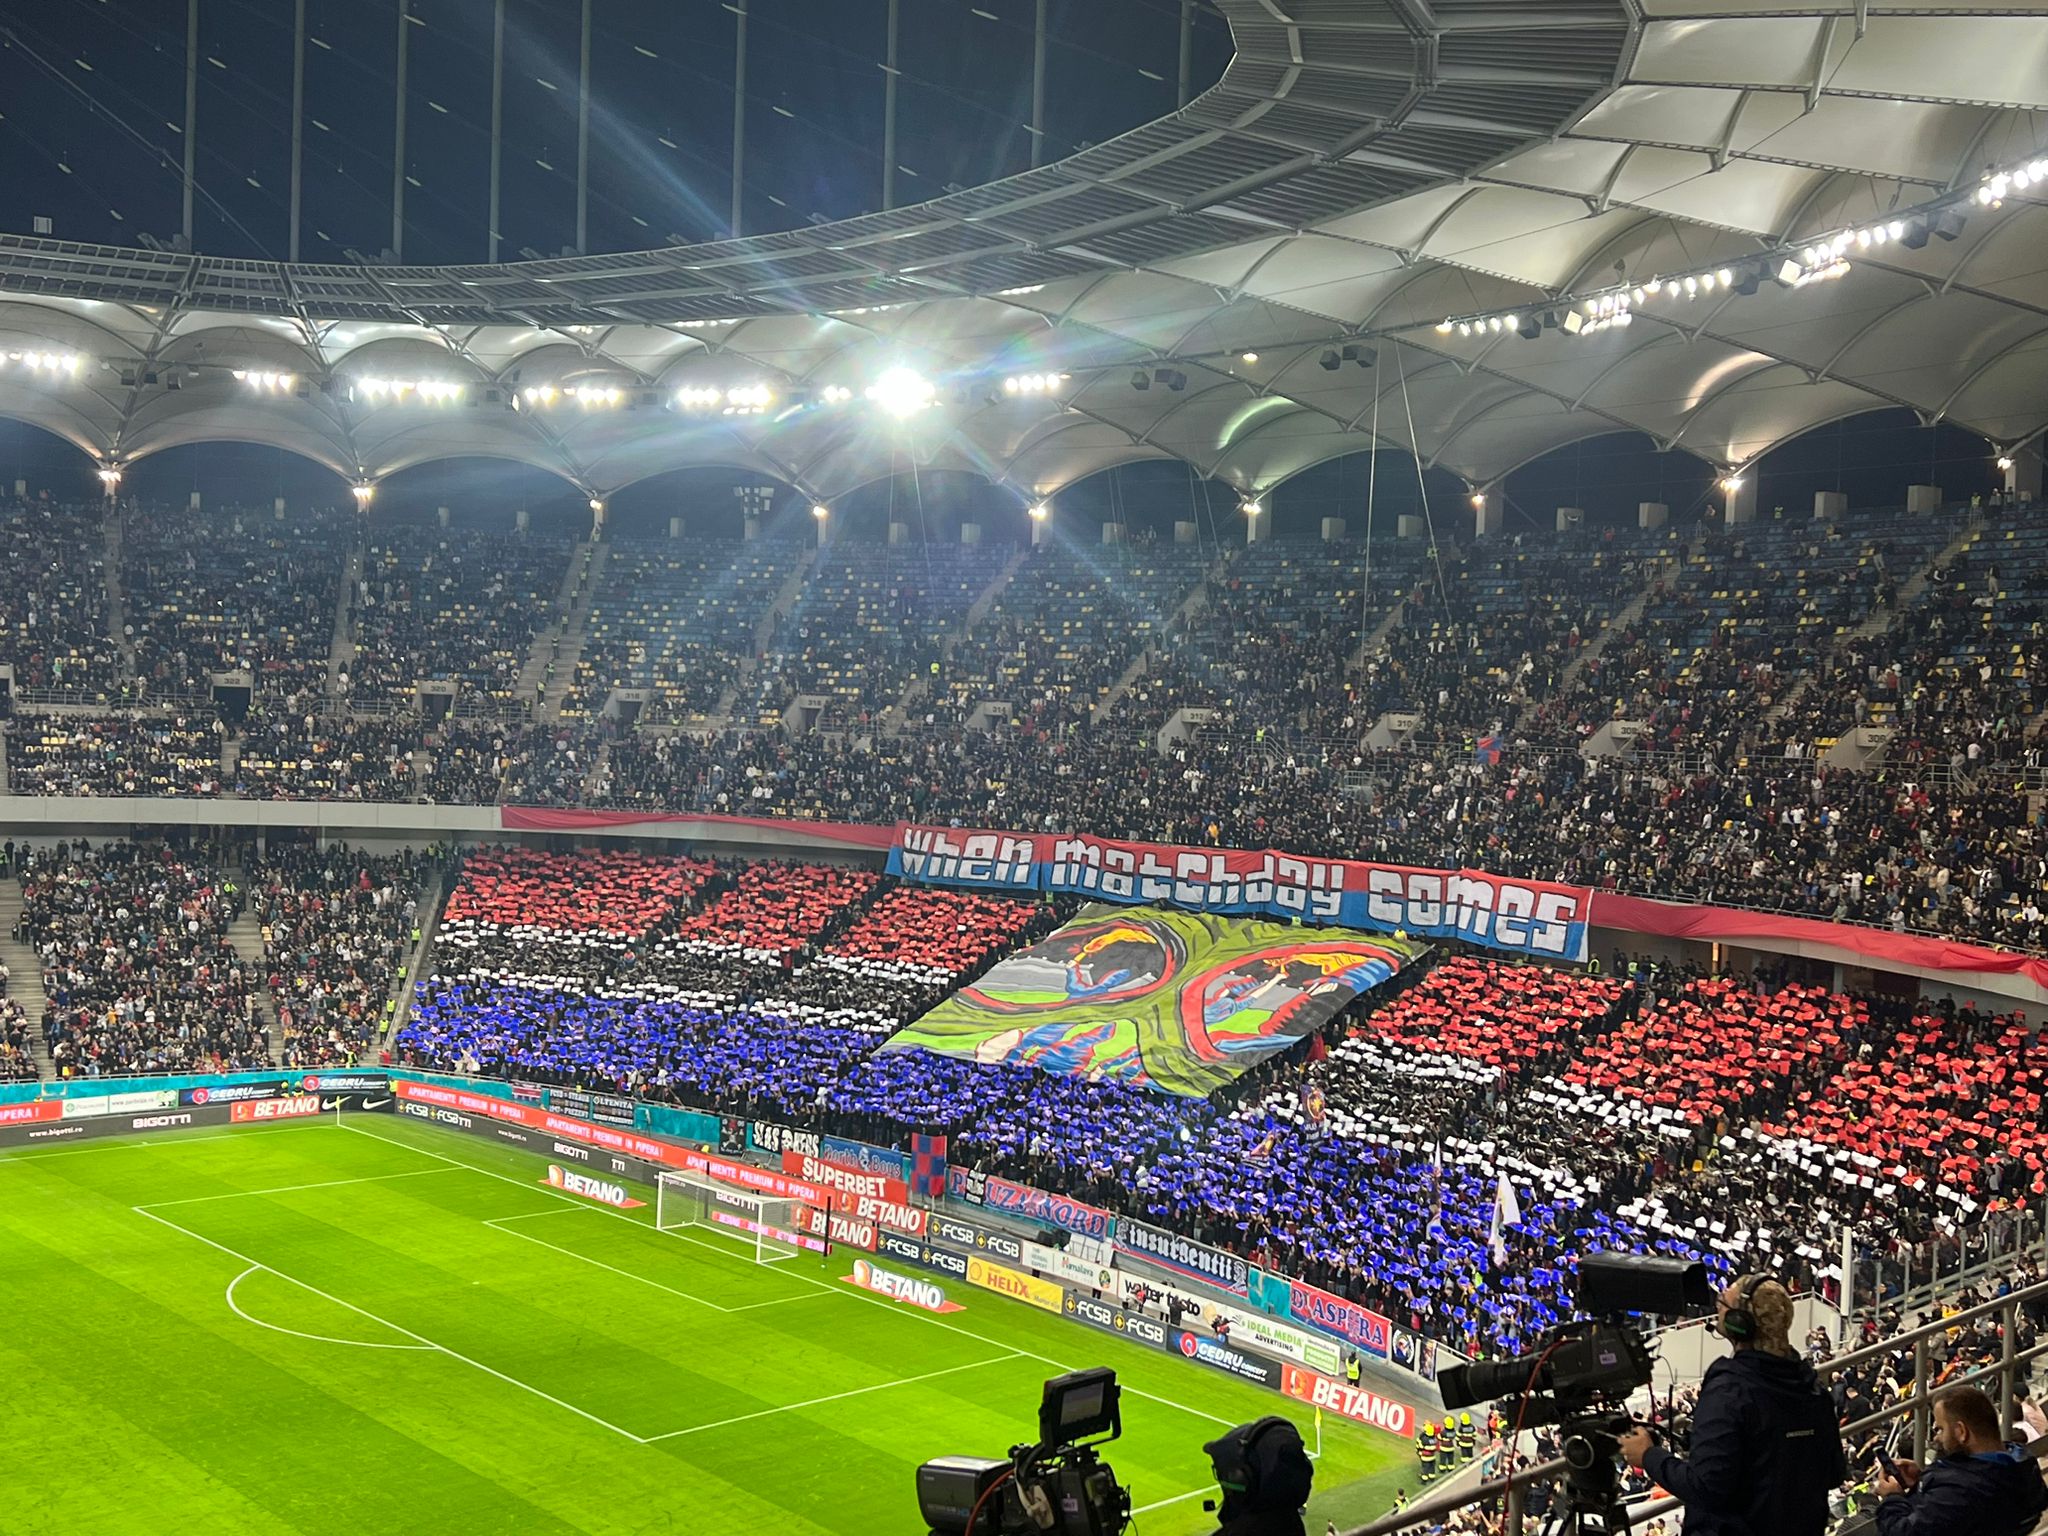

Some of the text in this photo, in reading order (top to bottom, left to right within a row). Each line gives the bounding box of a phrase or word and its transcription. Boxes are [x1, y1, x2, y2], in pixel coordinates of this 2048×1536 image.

[903, 828, 1577, 953] when matchday comes
[133, 1114, 190, 1128] BIGOTTI
[254, 1098, 319, 1117] BETANO
[29, 1127, 83, 1138] www.bigotti.ro
[554, 1142, 588, 1161] BIGOTTI
[565, 1172, 625, 1205] BETANO
[802, 1158, 886, 1198] SUPERBET
[951, 1172, 1026, 1210] PUZA
[857, 1196, 920, 1231] BETANO
[886, 1238, 919, 1259] FCSB
[931, 1252, 965, 1273] FCSB
[941, 1224, 1019, 1257] FCSB FCSB
[870, 1268, 941, 1308] BETANO
[988, 1272, 1030, 1298] HELIX
[1076, 1301, 1164, 1343] FCSB FCSB
[1291, 1288, 1383, 1344] DIASPRA
[1247, 1320, 1271, 1336] IDEAL
[1274, 1329, 1302, 1347] MEDIA
[1198, 1343, 1244, 1368] CEDRU
[1312, 1377, 1405, 1432] BETANO
